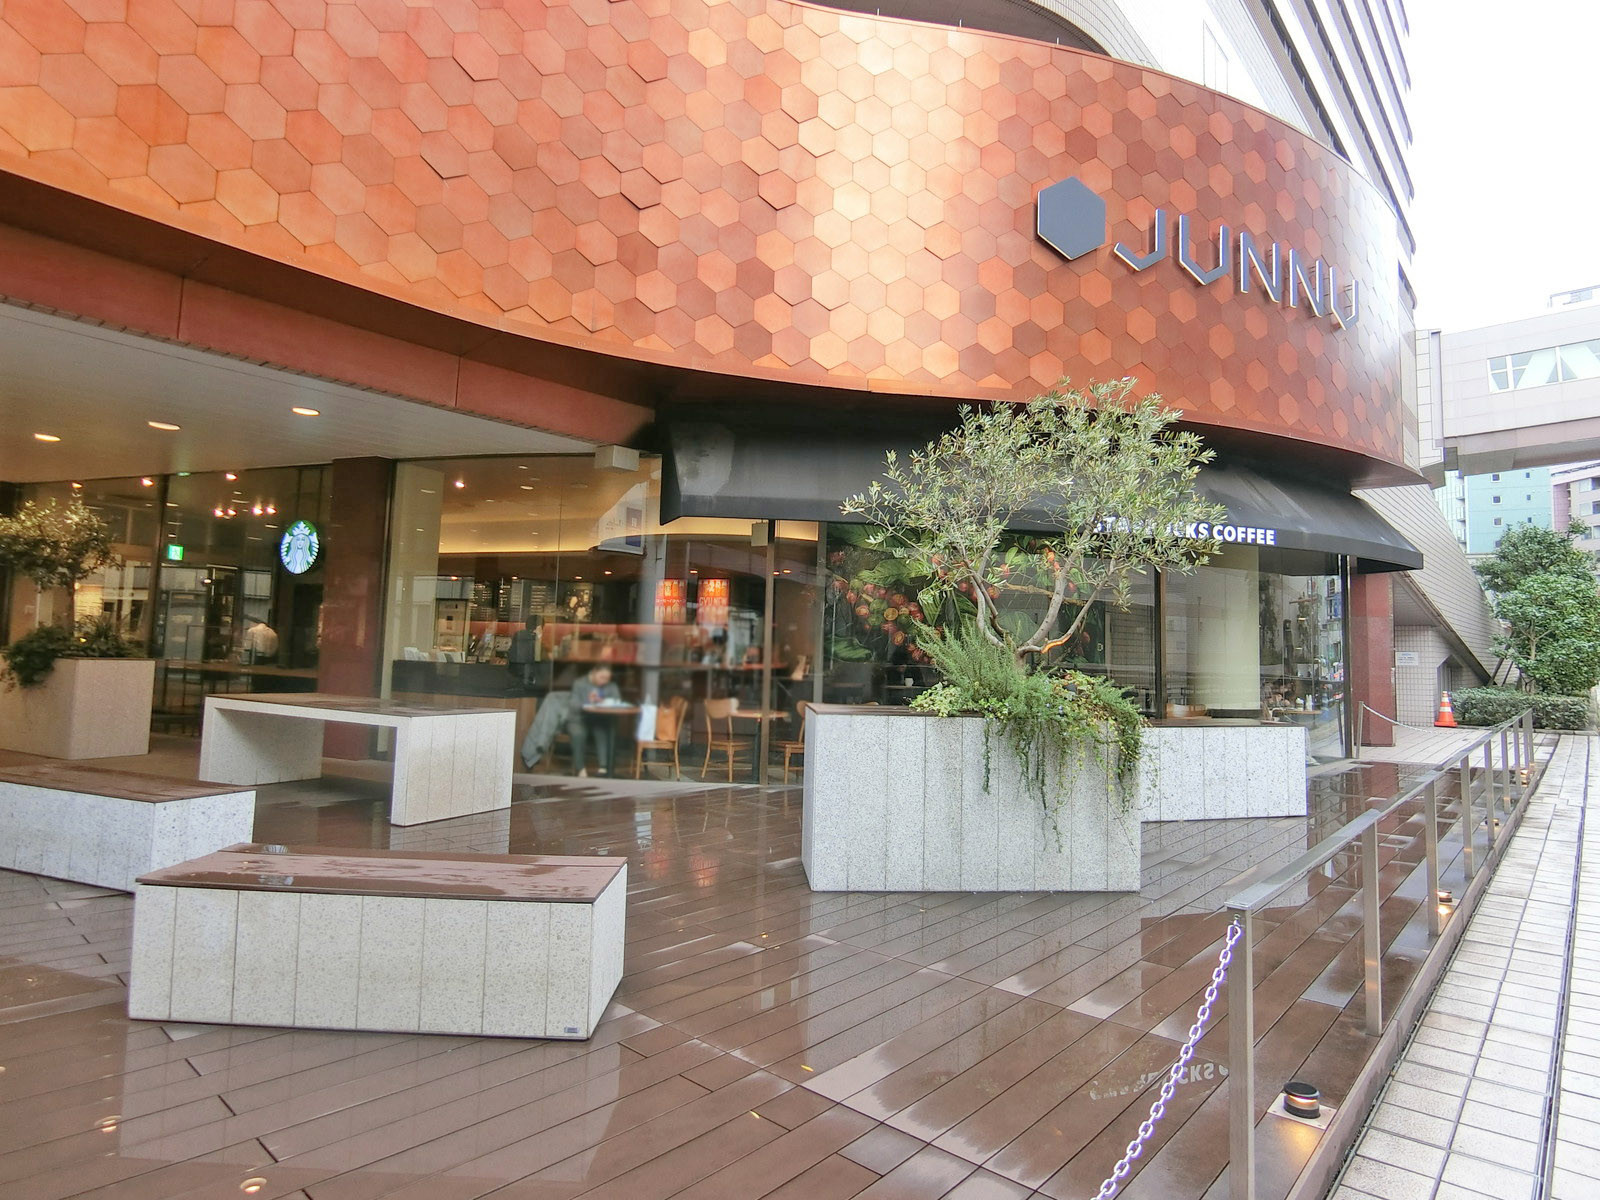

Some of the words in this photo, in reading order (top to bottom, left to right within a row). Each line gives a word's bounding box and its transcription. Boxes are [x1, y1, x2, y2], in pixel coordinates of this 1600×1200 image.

[1113, 208, 1359, 331] JUNNU
[1093, 516, 1209, 539] TACKS
[1212, 524, 1276, 545] COFFEE
